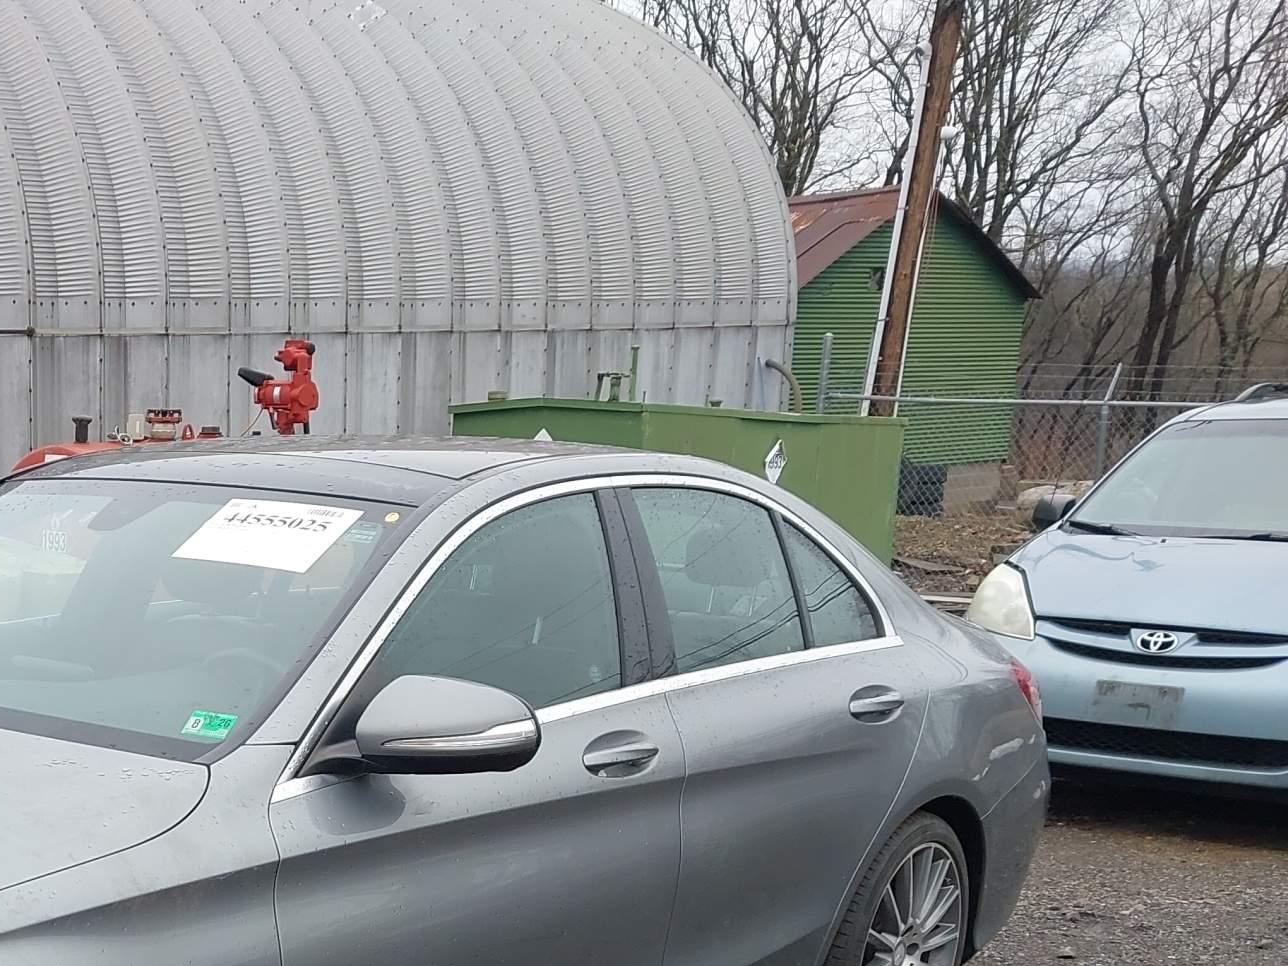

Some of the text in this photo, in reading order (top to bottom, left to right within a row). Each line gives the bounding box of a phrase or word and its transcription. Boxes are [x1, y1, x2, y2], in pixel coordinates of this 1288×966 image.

[224, 512, 333, 532] 44555025
[43, 529, 66, 552] 1993
[191, 718, 201, 729] 8
